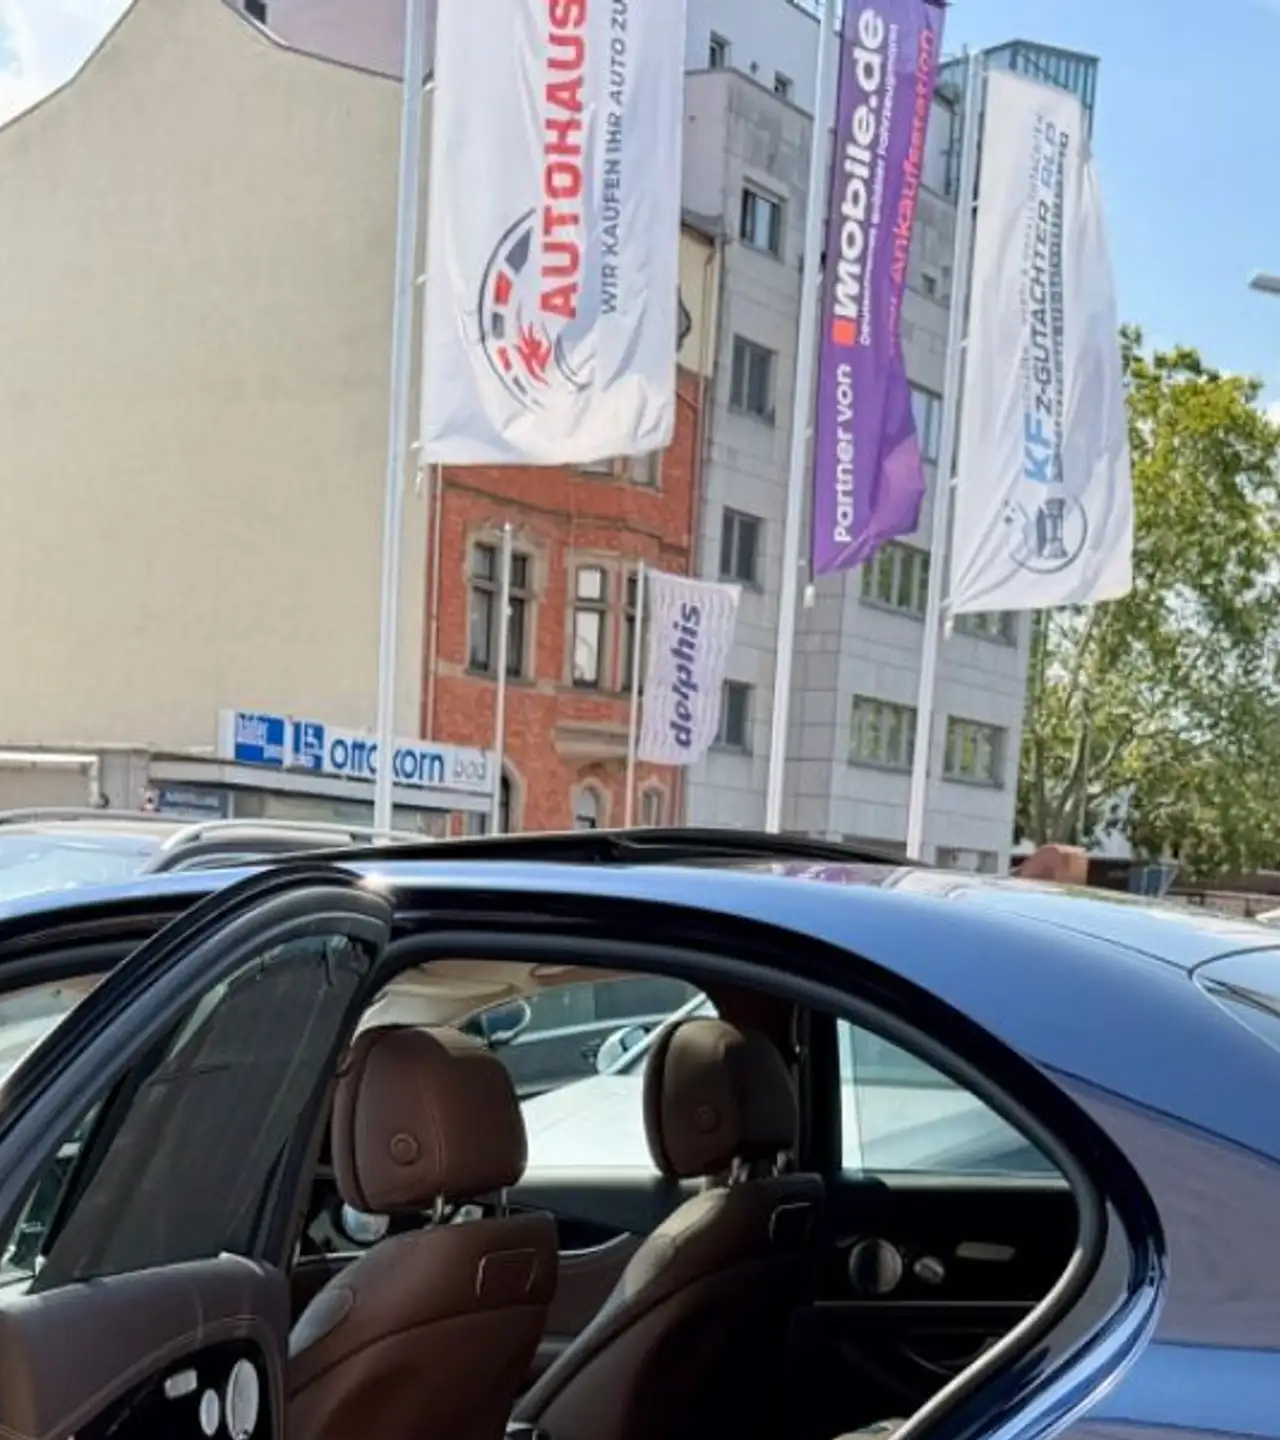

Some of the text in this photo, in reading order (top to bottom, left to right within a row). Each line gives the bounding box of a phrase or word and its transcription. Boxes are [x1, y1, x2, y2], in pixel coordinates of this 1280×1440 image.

[604, 112, 622, 153] IHR
[608, 37, 627, 107] AUTO
[539, 0, 587, 320] AUTOHAUS
[601, 160, 622, 257] KAUFEN
[833, 8, 885, 319] mobile.de
[601, 263, 618, 315] WIR
[833, 362, 854, 542] Partner von
[669, 601, 702, 749] delphis
